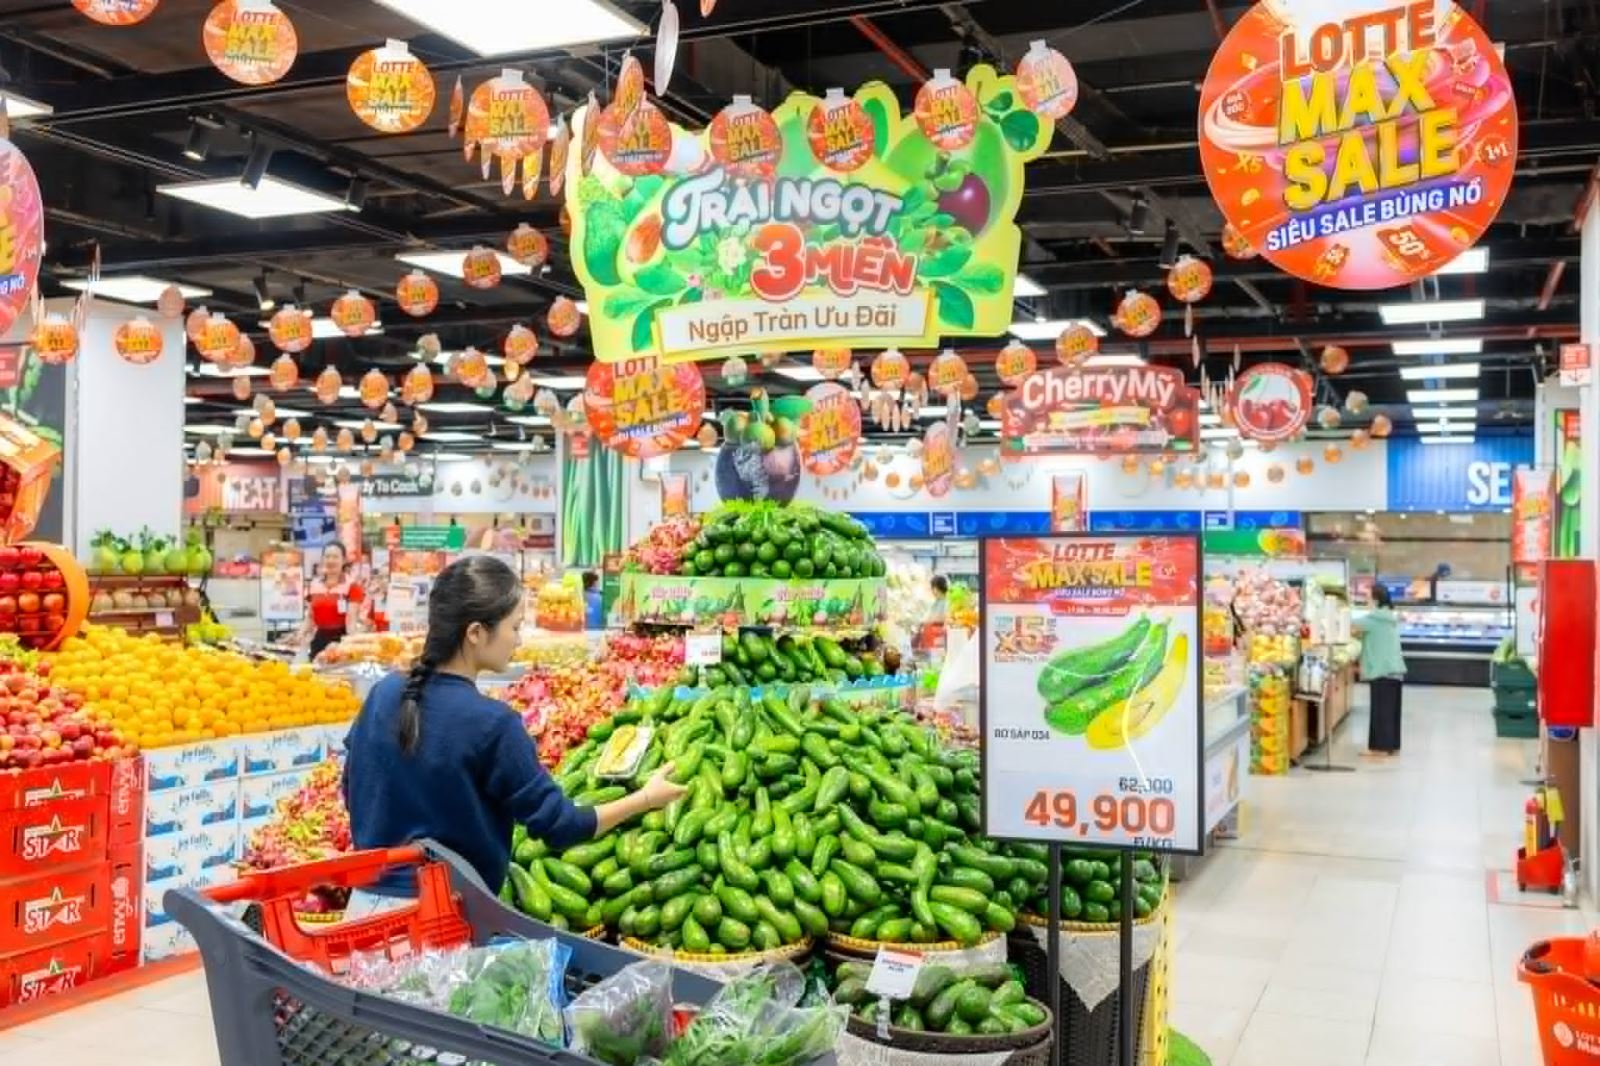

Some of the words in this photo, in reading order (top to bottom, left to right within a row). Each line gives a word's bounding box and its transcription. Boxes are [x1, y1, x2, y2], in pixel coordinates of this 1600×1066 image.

[1281, 2, 1438, 81] LOTTE
[1280, 48, 1437, 146] MAX
[1283, 107, 1462, 212] SALE
[778, 178, 903, 235] NGỌT
[1266, 216, 1315, 250] SIÊU
[1320, 203, 1377, 235] SALE
[1380, 187, 1445, 221] BÙNG
[752, 223, 804, 299] 3
[803, 234, 917, 293] MIỀN
[688, 314, 749, 342] Ngập
[753, 307, 808, 333] Tràn
[814, 304, 849, 328] Ưu
[855, 303, 897, 328] Đãi
[1466, 461, 1512, 505] SE
[1031, 562, 1087, 588] MAX
[1088, 561, 1151, 587] SALE
[1053, 543, 1116, 562] LOTTE
[1024, 790, 1176, 836] 49,900
